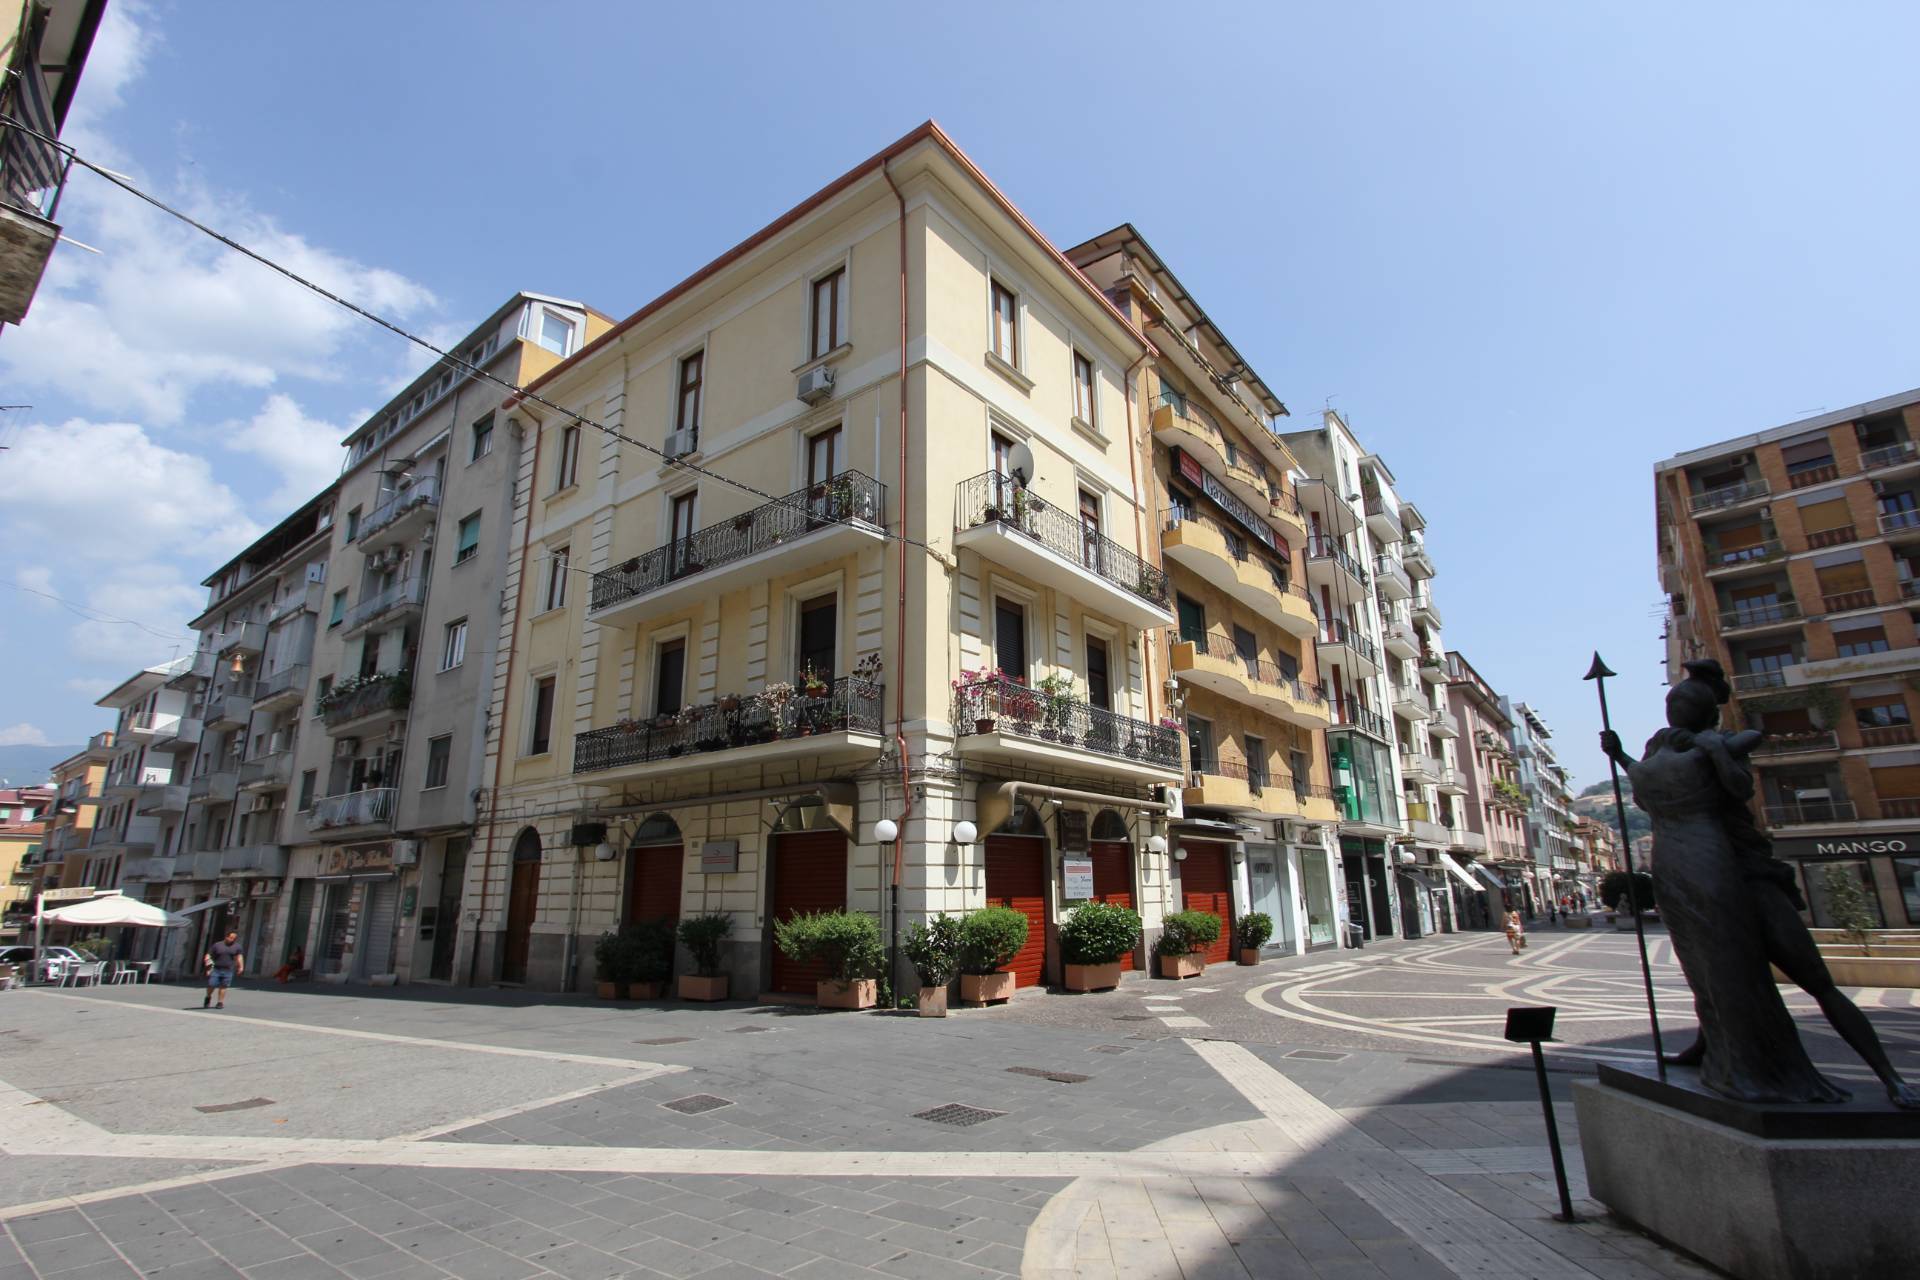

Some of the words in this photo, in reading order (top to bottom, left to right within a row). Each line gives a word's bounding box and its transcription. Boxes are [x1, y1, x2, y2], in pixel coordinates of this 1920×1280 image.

[1206, 474, 1244, 520] Gazzetta
[1244, 506, 1257, 532] del
[1257, 519, 1272, 545] Sud
[1817, 840, 1906, 854] MANGO
